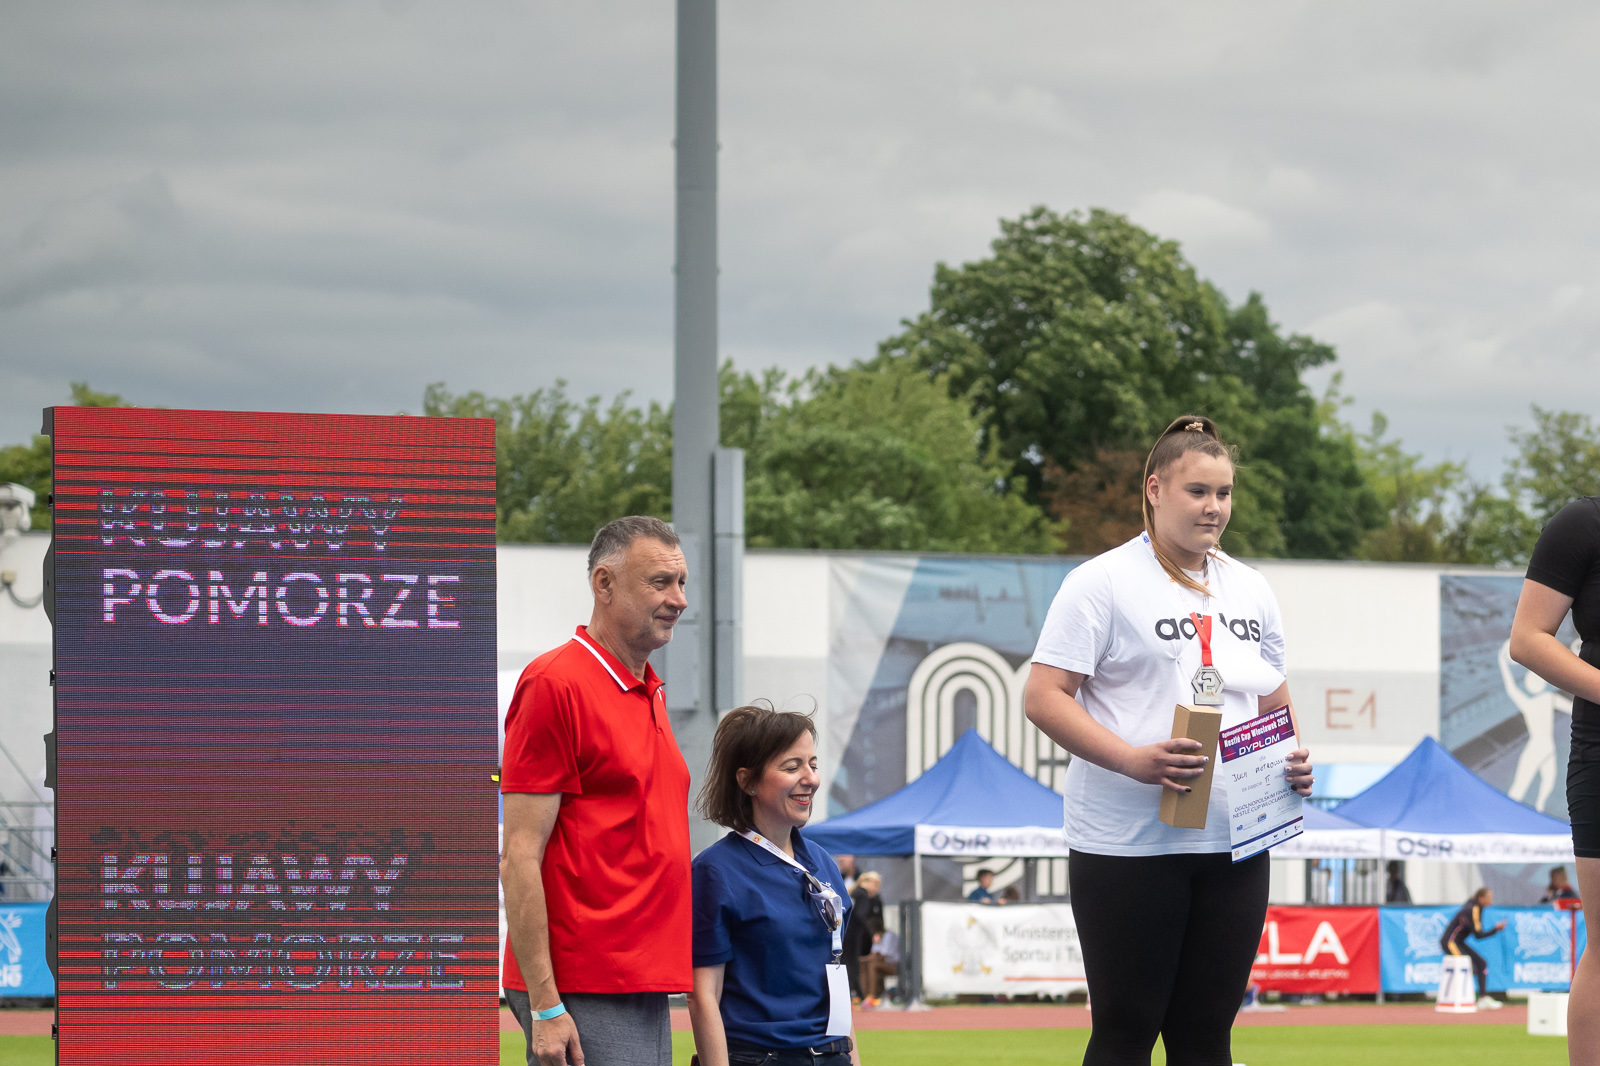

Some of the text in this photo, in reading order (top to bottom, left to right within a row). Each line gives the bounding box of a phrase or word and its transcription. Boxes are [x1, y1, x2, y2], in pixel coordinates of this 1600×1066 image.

[102, 568, 461, 629] POMORZE
[1325, 687, 1376, 730] E1
[1238, 733, 1280, 756] DYPLOM
[103, 853, 408, 911] KUJAWY
